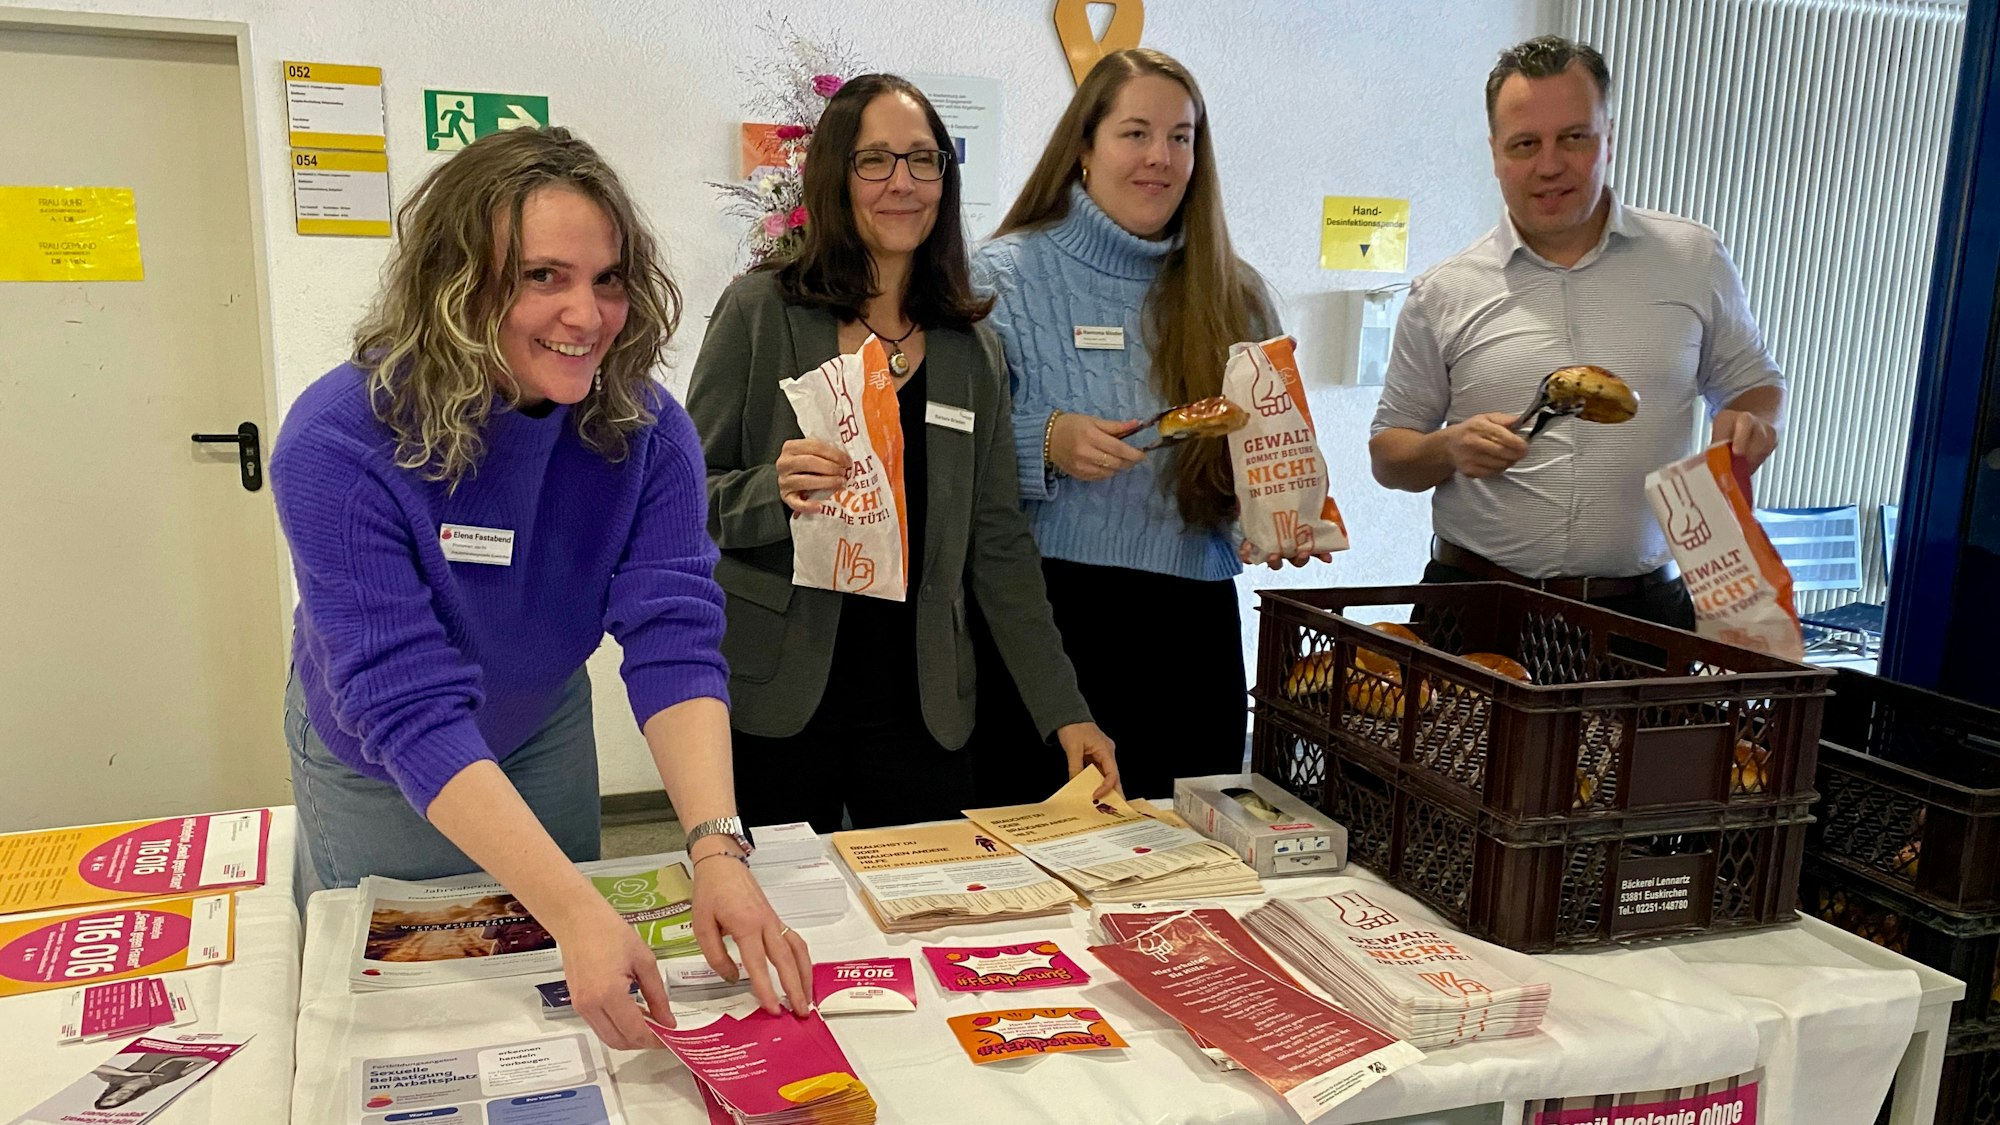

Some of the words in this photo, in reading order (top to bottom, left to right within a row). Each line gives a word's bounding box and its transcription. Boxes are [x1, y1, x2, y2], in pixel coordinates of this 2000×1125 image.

[289, 65, 311, 78] 052
[296, 154, 318, 167] 054
[1353, 206, 1382, 216] Hand-
[1326, 218, 1406, 229] Desinfektionsspender
[1244, 429, 1309, 453] GEWALT
[1246, 452, 1279, 466] KOMMT
[1281, 448, 1298, 458] BEI
[1247, 456, 1316, 485] NICHT
[1249, 487, 1261, 498] IN
[1264, 483, 1286, 495] DIE
[821, 505, 837, 517] IN
[453, 531, 474, 540] Elena
[475, 533, 512, 543] Fastabend
[1684, 549, 1741, 585] EWALT
[138, 839, 172, 854] 116
[850, 841, 900, 851] BRAUCHST
[857, 850, 910, 860] BRAUCHEN
[132, 856, 168, 876] 016
[424, 882, 501, 894] Jahresberich
[1621, 877, 1655, 890] Bäckerei
[1656, 875, 1691, 886] Lennartz
[1620, 891, 1643, 902] 53881
[1644, 888, 1688, 900] Euskirchen
[1618, 905, 1635, 915] Tel.:
[1635, 899, 1689, 914] 02251-148780
[73, 915, 125, 944] 116
[1348, 930, 1440, 946] GEWALT
[1364, 945, 1461, 960] NICHT
[64, 944, 120, 977] 016
[1151, 967, 1172, 977] Hier
[1171, 955, 1211, 974] erhalten
[837, 969, 861, 978] 116
[864, 968, 894, 978] 016
[1168, 970, 1184, 979] Sie
[1183, 964, 1209, 976] Hilfe:
[498, 1046, 541, 1055] erkennen
[499, 1053, 536, 1061] handeln
[500, 1057, 550, 1067] vorbeugen
[369, 1066, 429, 1077] Sexuelle
[369, 1070, 453, 1083] Belästigung
[393, 1073, 478, 1088] Arbeitsplatz
[1701, 1100, 1743, 1124] ohne
